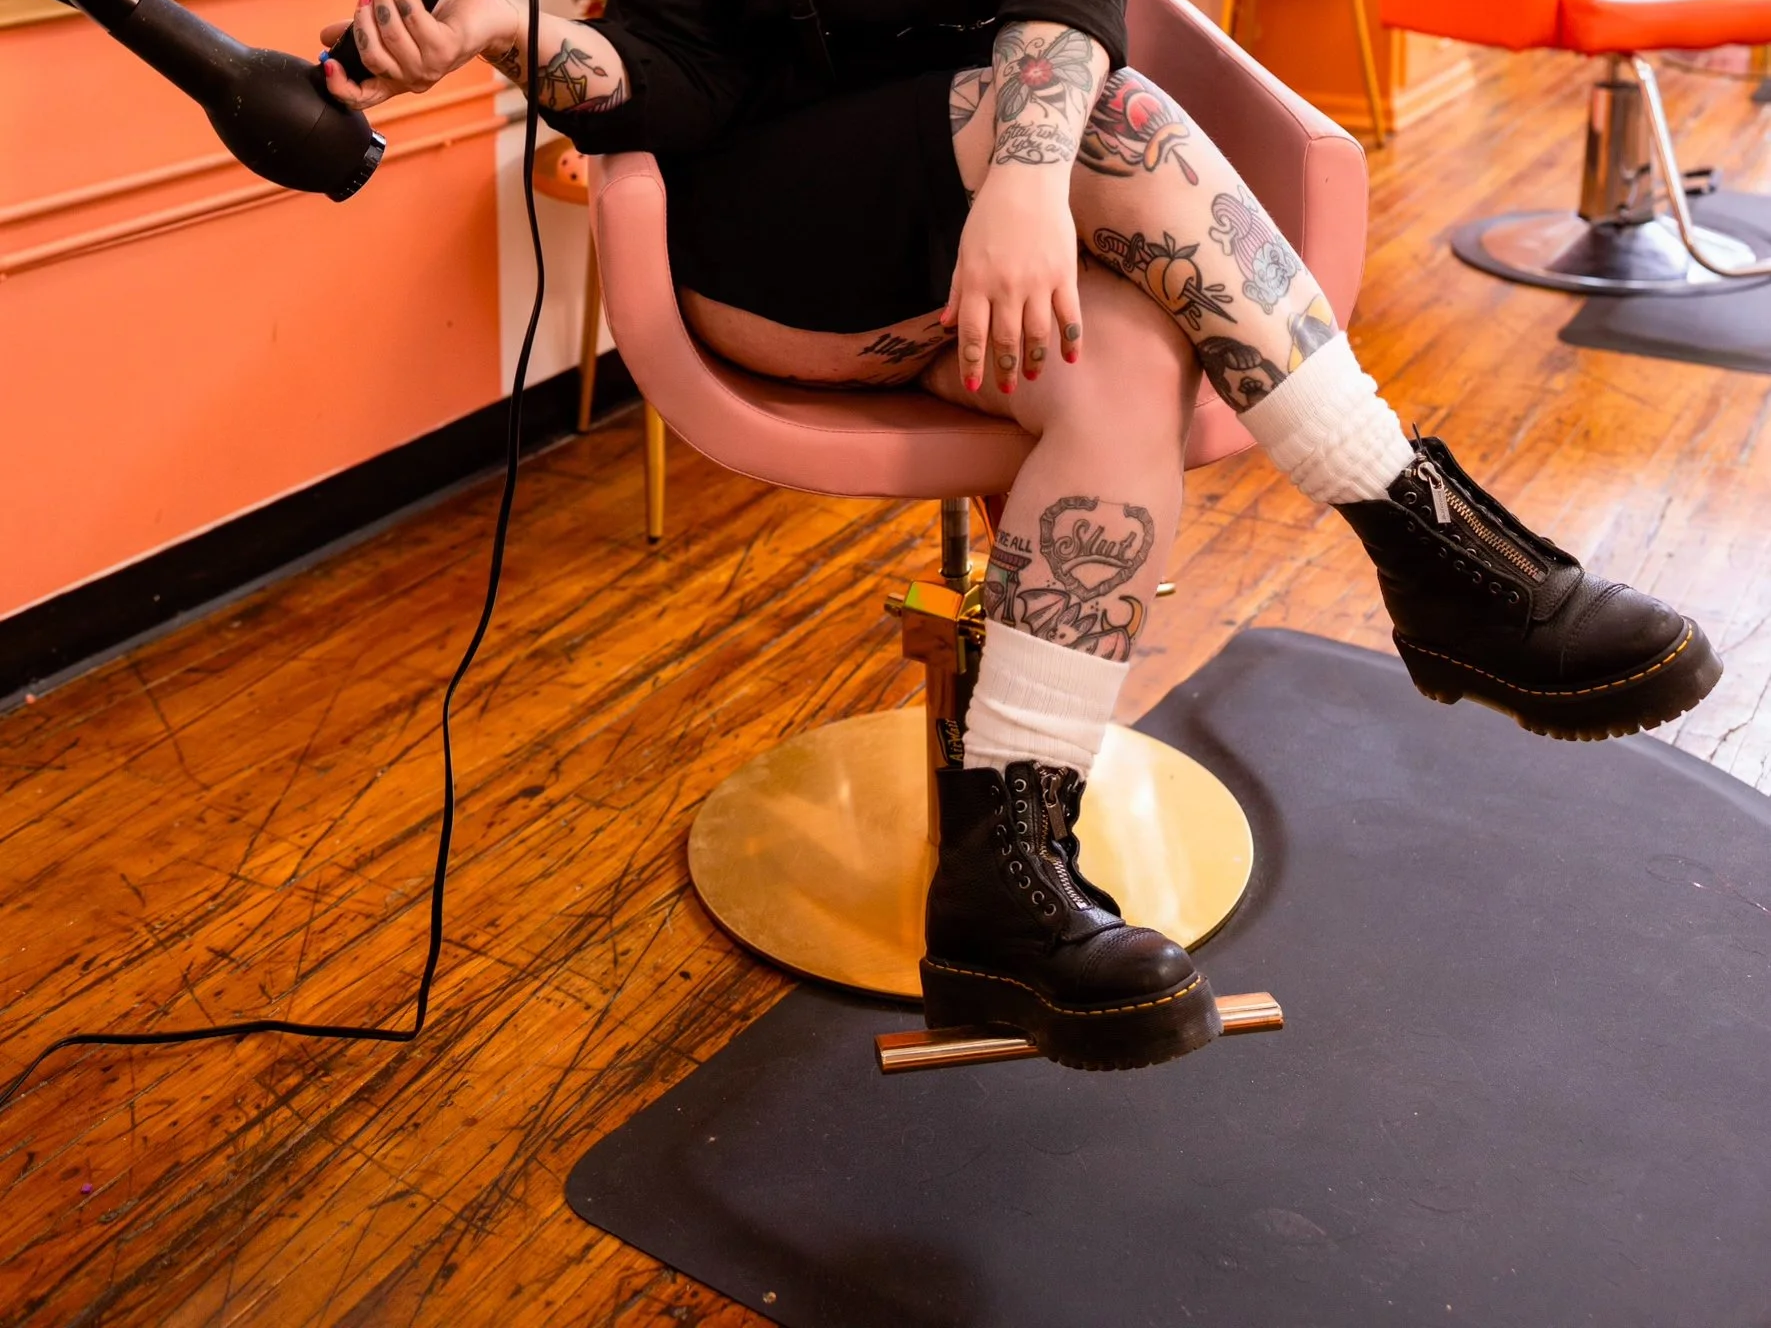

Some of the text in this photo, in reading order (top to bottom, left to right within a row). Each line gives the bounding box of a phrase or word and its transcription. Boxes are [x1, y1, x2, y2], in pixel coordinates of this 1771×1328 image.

[1006, 137, 1043, 155] you
[1010, 535, 1033, 553] ALL
[1053, 519, 1137, 561] Slut
